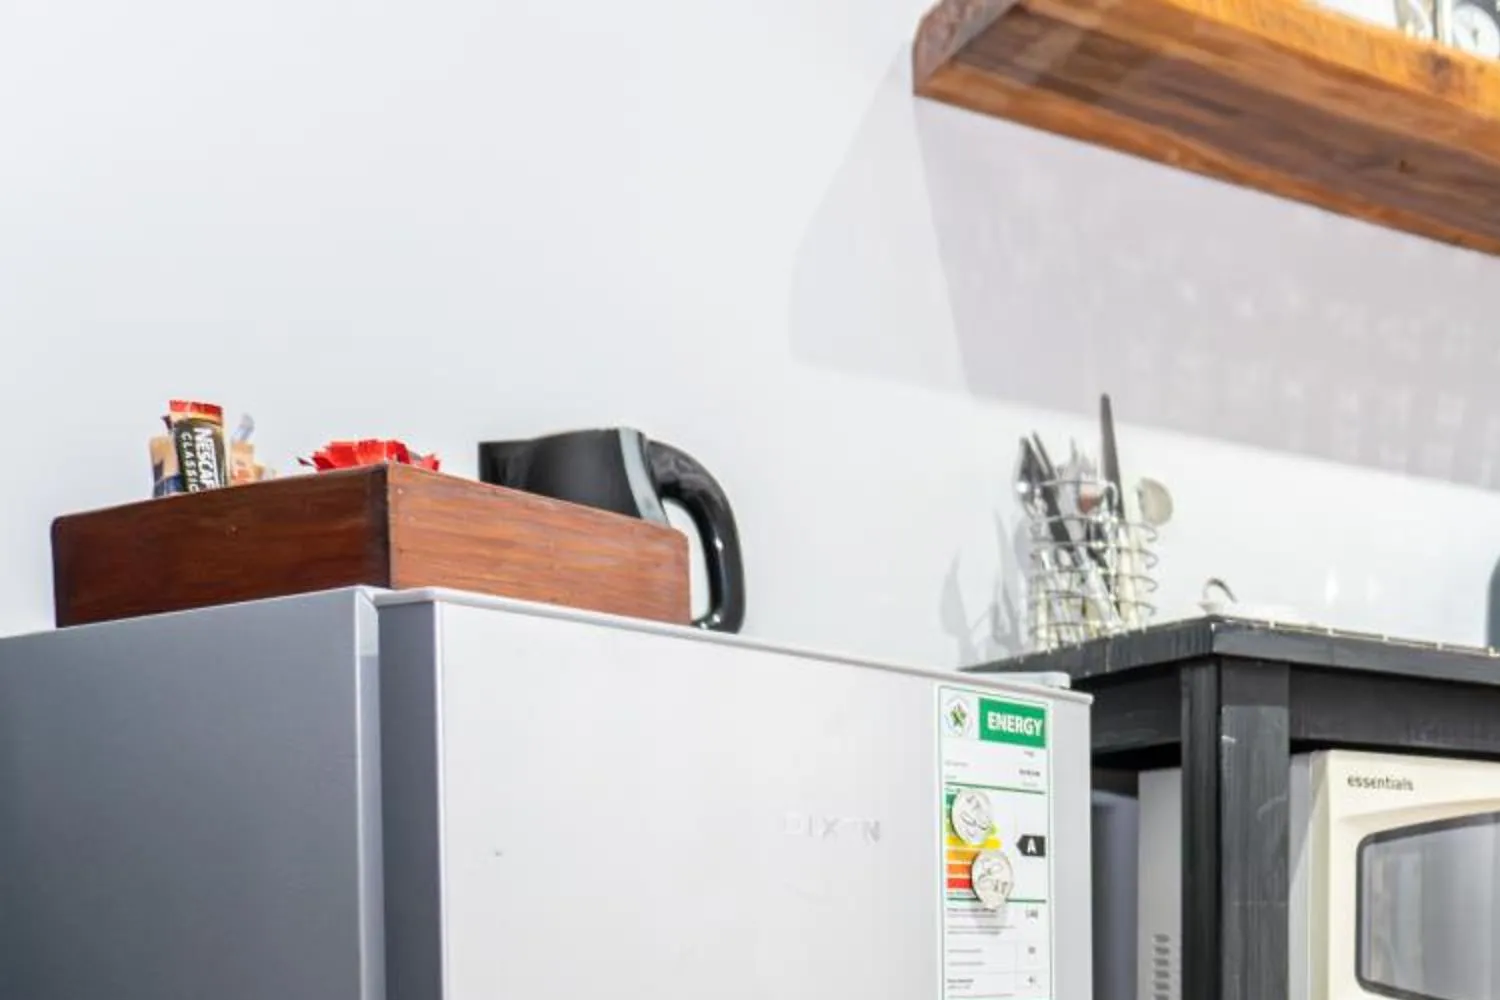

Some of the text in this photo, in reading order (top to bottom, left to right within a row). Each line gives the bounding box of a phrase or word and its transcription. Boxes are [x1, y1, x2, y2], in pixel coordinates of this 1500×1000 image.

[180, 431, 200, 493] CLASSIC
[193, 427, 219, 490] NESCAF
[987, 711, 1043, 736] ENERGY
[1347, 775, 1414, 792] essentials
[1027, 838, 1037, 854] A
